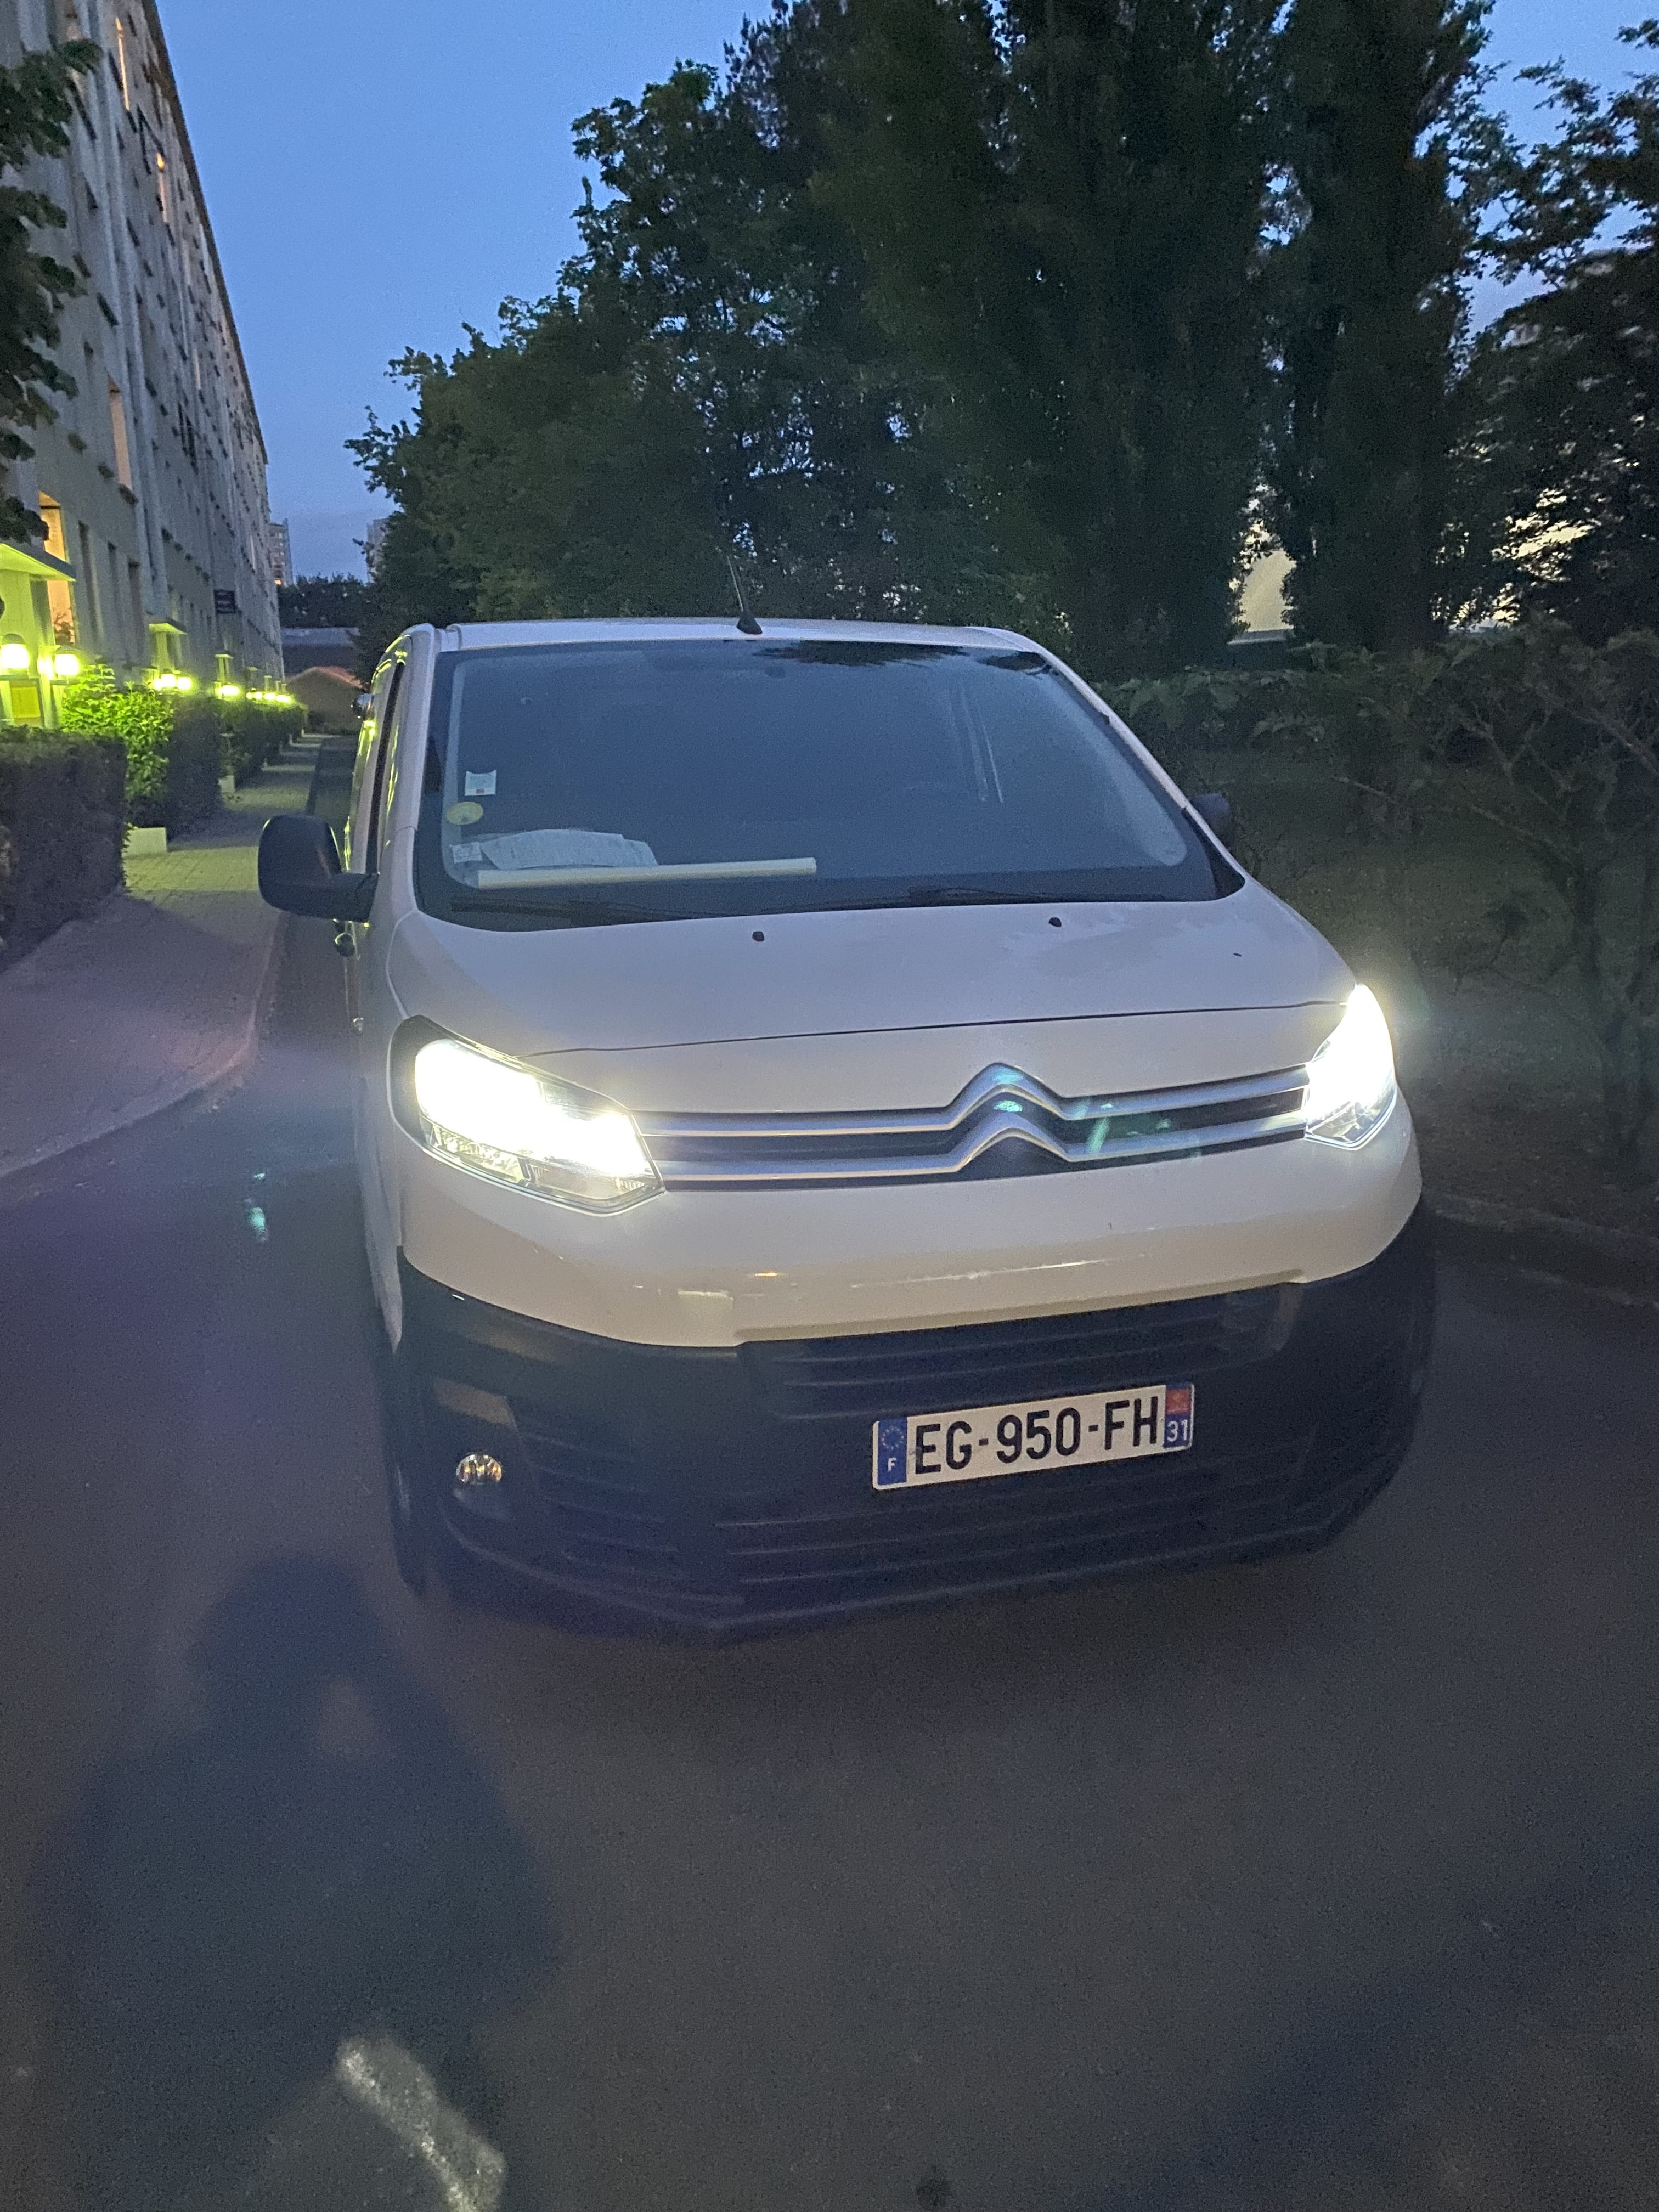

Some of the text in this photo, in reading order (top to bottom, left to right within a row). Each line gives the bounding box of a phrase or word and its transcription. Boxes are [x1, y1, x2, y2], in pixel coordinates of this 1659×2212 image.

[915, 1396, 1159, 1475] EG-950-FH
[1167, 1419, 1189, 1443] 31
[888, 1457, 897, 1472] F
